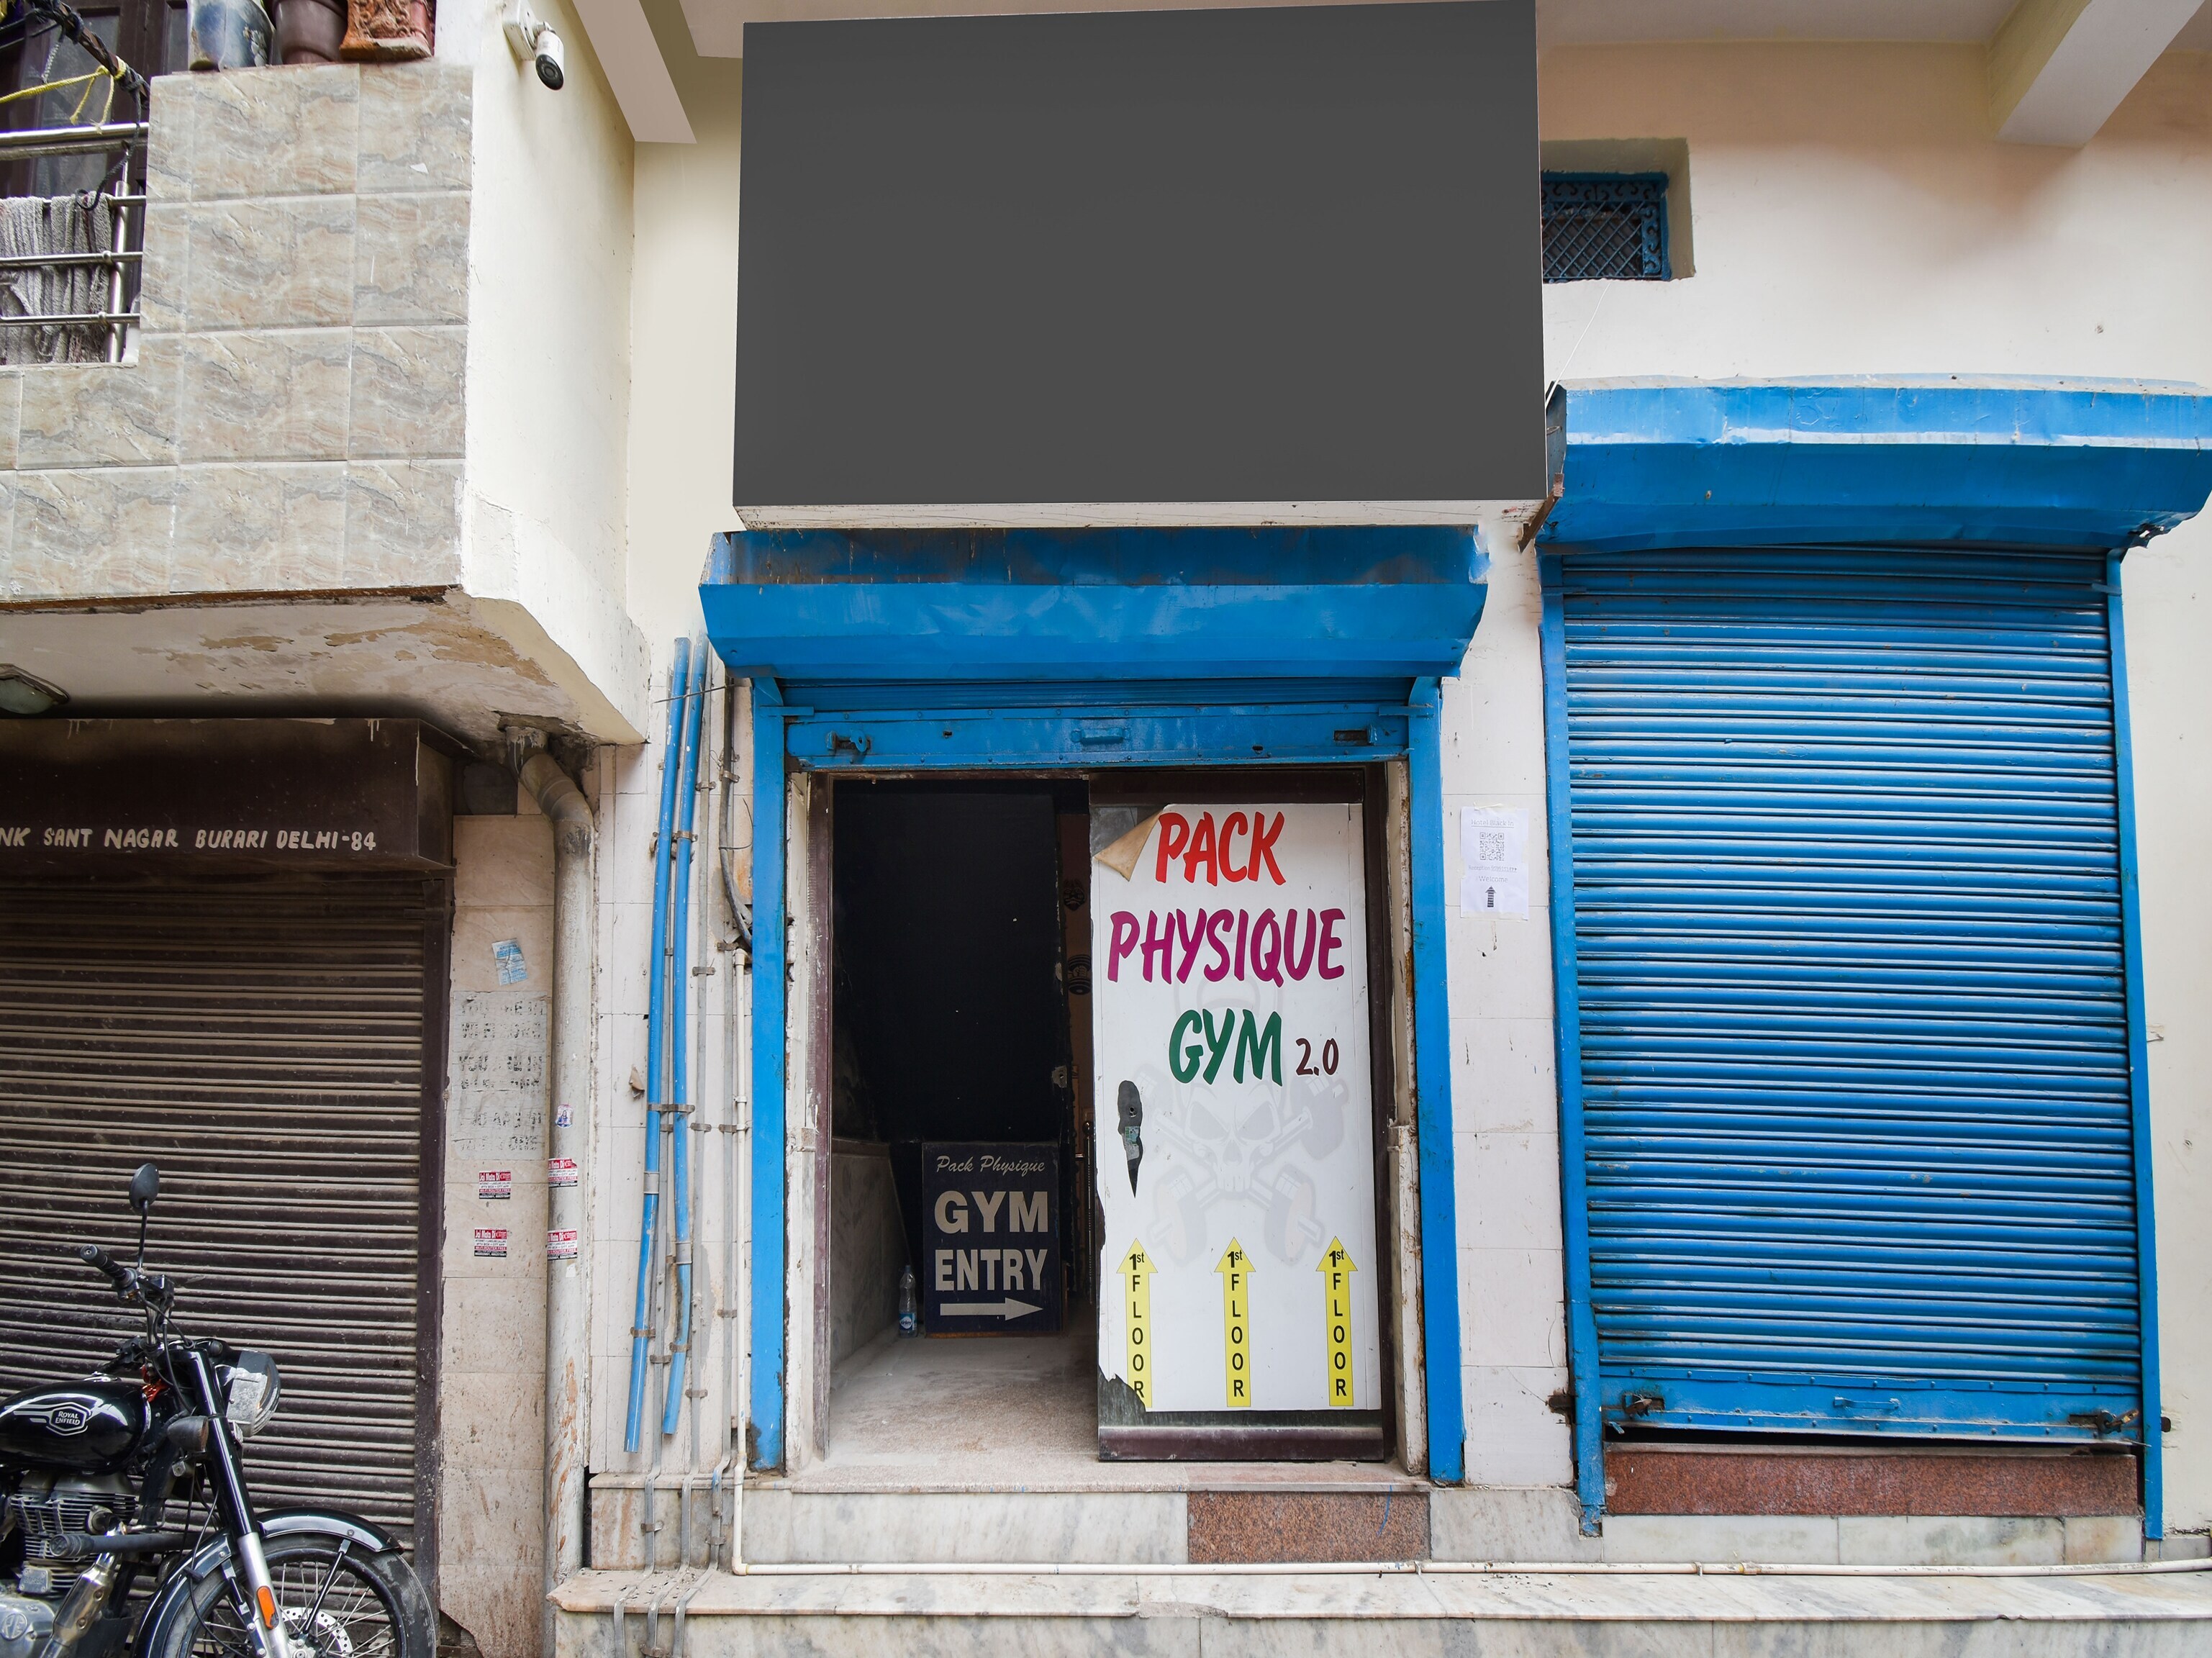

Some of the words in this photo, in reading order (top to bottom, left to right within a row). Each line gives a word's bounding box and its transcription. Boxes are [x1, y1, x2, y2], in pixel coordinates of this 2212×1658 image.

[44, 828, 93, 848] SANT
[104, 828, 178, 849] NAGAR
[196, 829, 268, 849] BURARI
[276, 829, 376, 851] DELHI-84
[1155, 811, 1286, 886] PACK
[1107, 908, 1346, 987] PHYSIQUE
[1169, 1008, 1283, 1087] GYM
[1295, 1038, 1338, 1076] 2.0
[936, 1156, 974, 1173] Pack
[980, 1155, 1045, 1177] Physique
[935, 1190, 1048, 1233] GYM
[935, 1249, 1047, 1291] ENTRY
[1132, 1275, 1144, 1398] FLOOR
[1231, 1274, 1243, 1397] FLOOR
[1333, 1273, 1346, 1396] FLOOR
